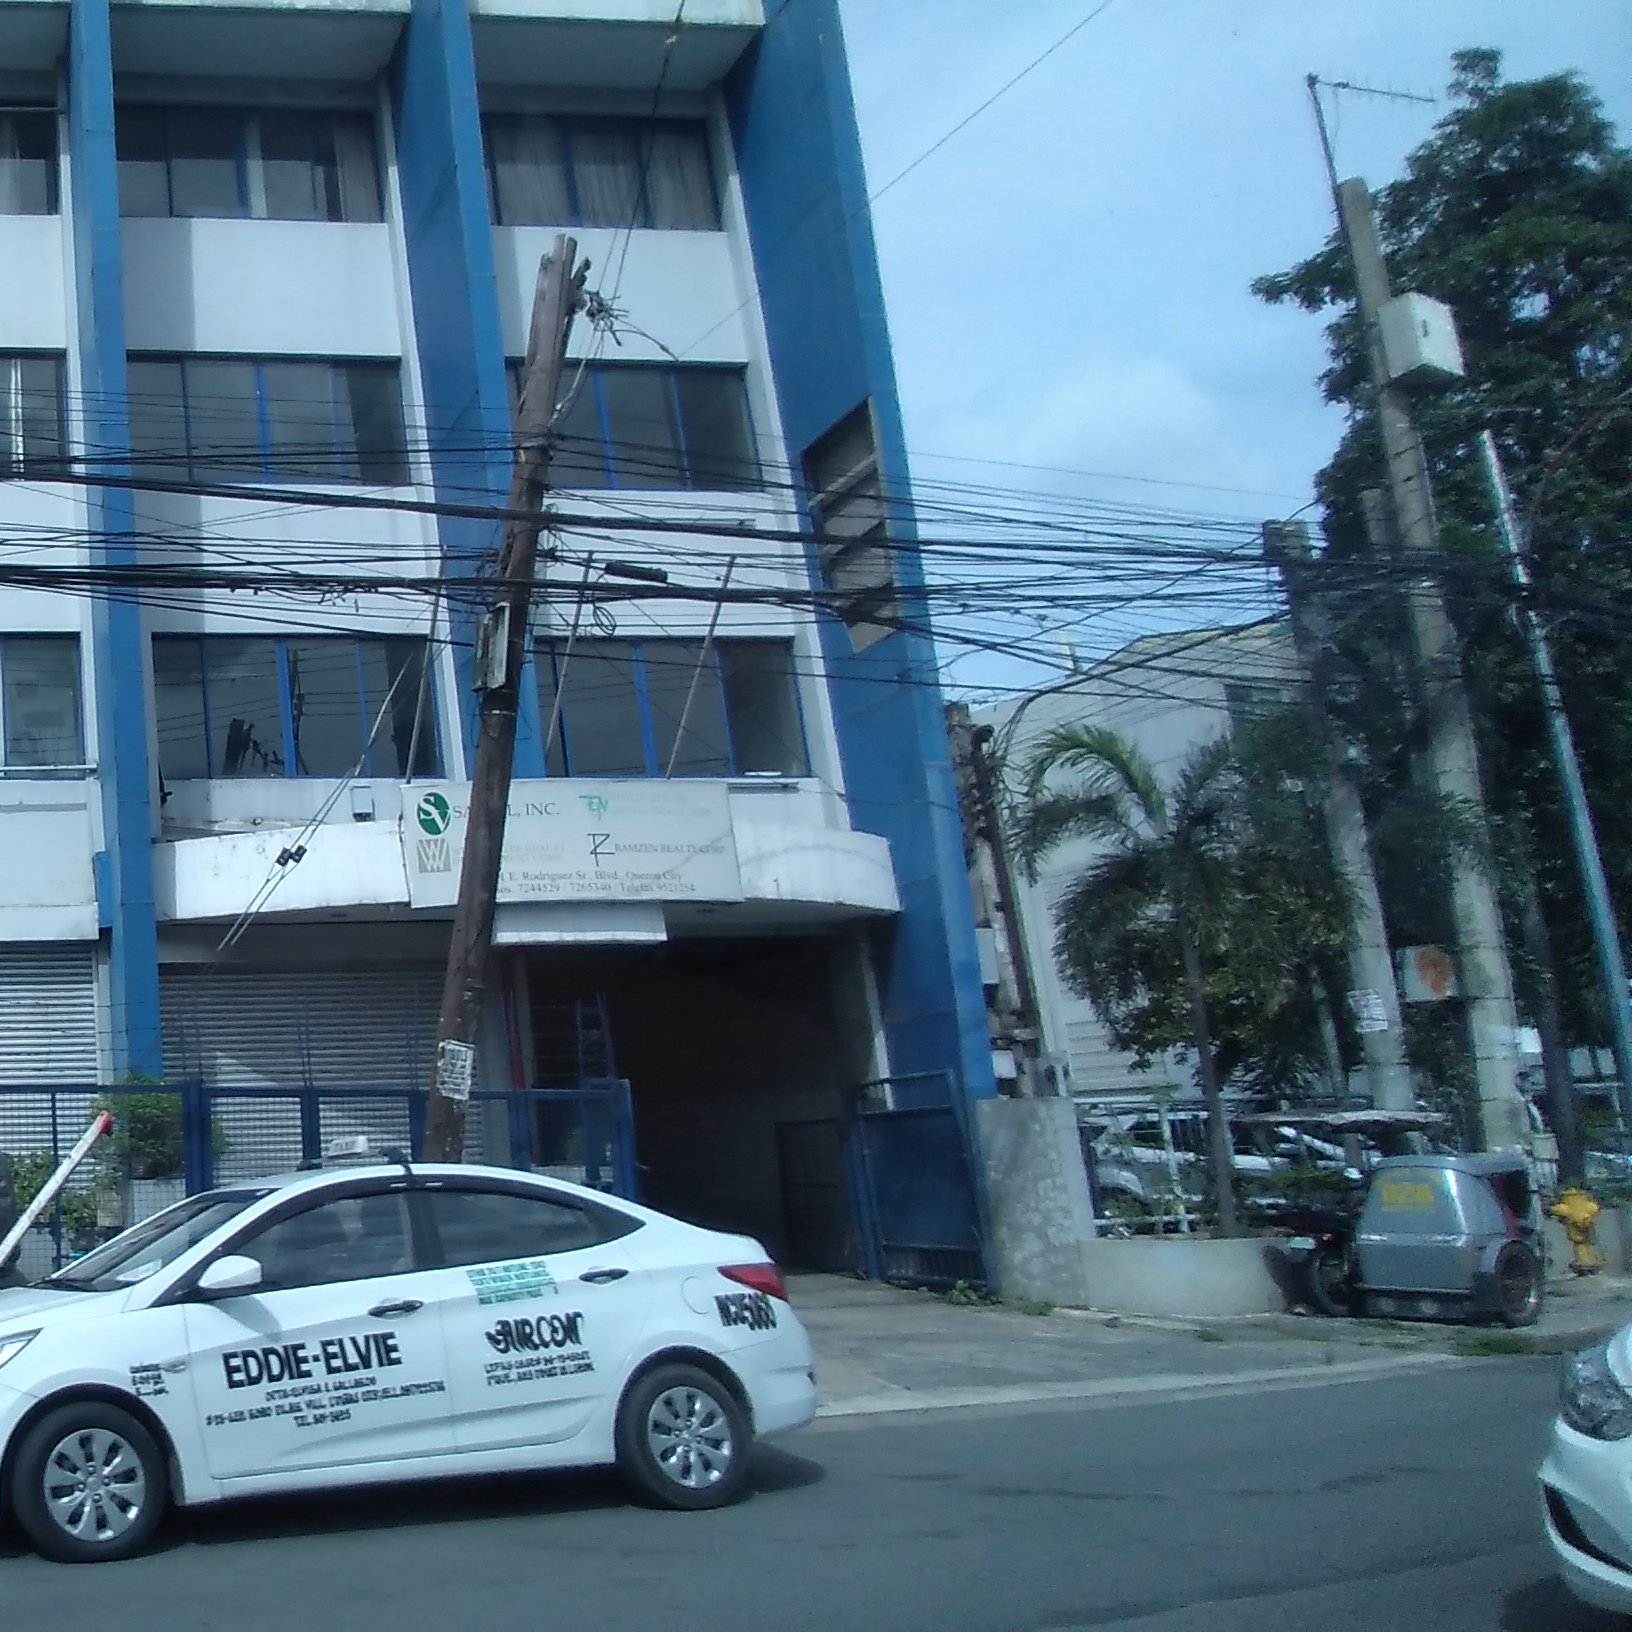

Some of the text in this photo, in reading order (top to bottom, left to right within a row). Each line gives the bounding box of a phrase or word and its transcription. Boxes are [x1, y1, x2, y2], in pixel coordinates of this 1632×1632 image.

[526, 802, 560, 816] INC.
[614, 843, 658, 853] RAMZEN
[660, 843, 695, 853] REALTY
[523, 871, 572, 884] Rodriguez
[625, 871, 661, 882] Quezon
[662, 871, 682, 883] City
[221, 1330, 403, 1389] EDDIE-ELVIE
